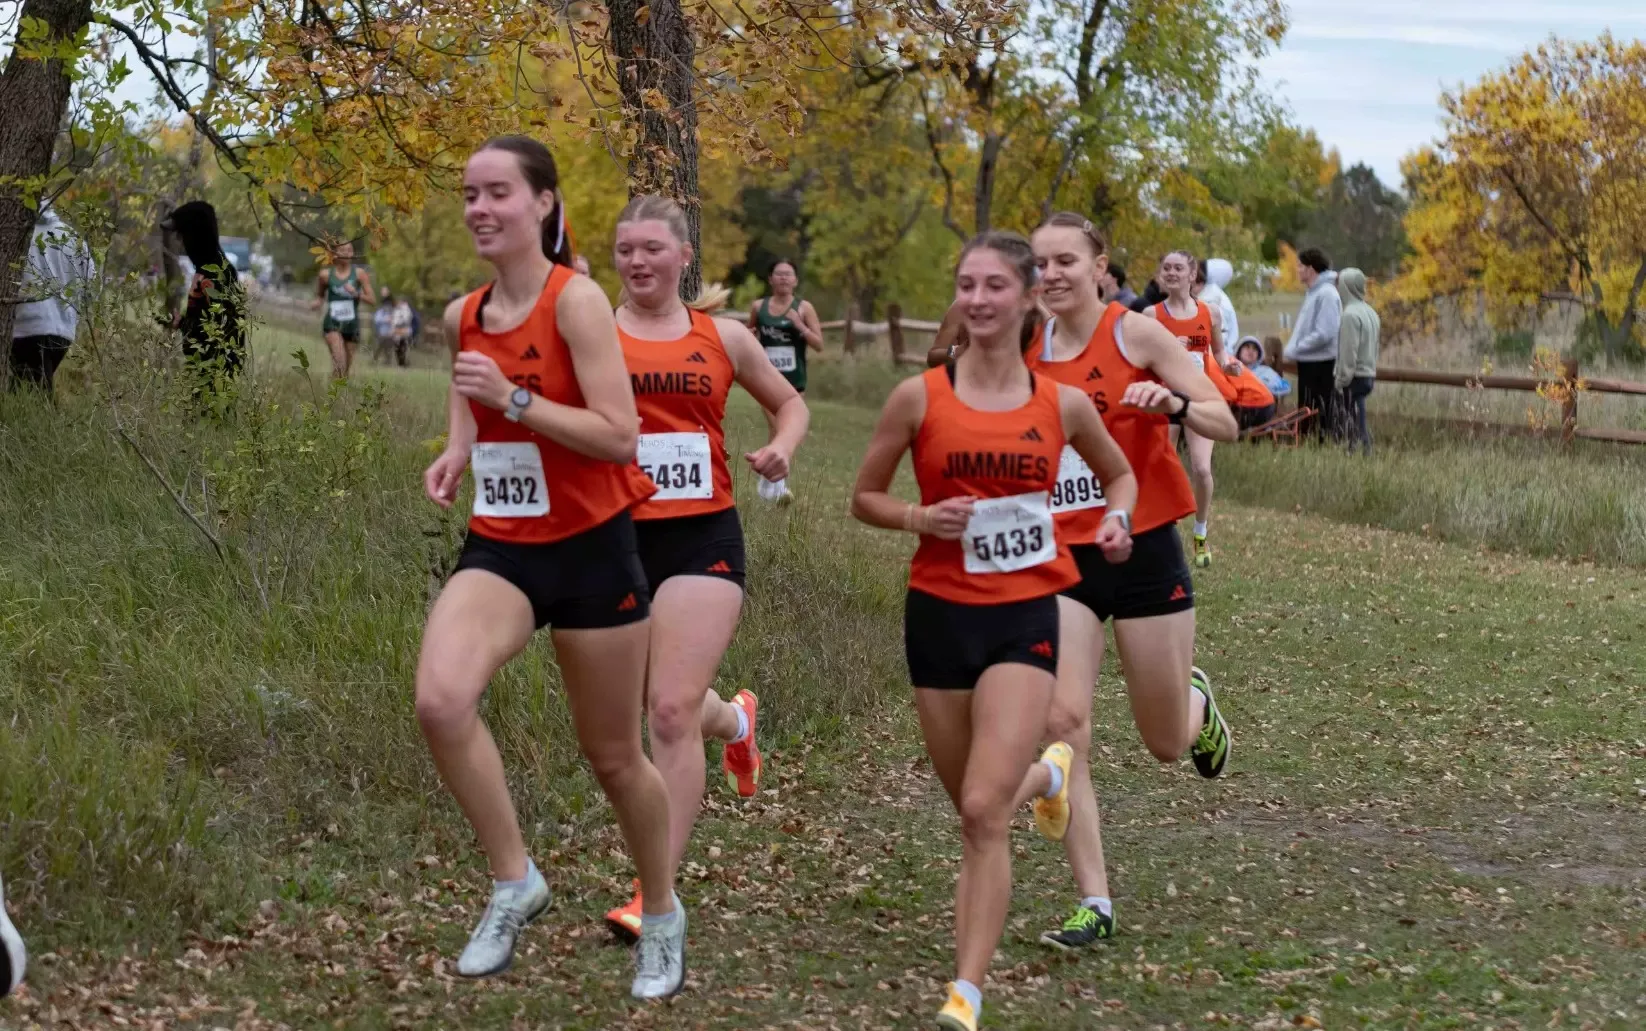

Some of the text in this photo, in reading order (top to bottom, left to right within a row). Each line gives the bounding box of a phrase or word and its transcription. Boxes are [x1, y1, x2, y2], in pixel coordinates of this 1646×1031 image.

[630, 372, 713, 397] MMIES
[942, 451, 1050, 482] JIMMIES
[483, 476, 539, 506] 5432
[1051, 475, 1105, 507] 9899
[973, 524, 1045, 561] 5433
